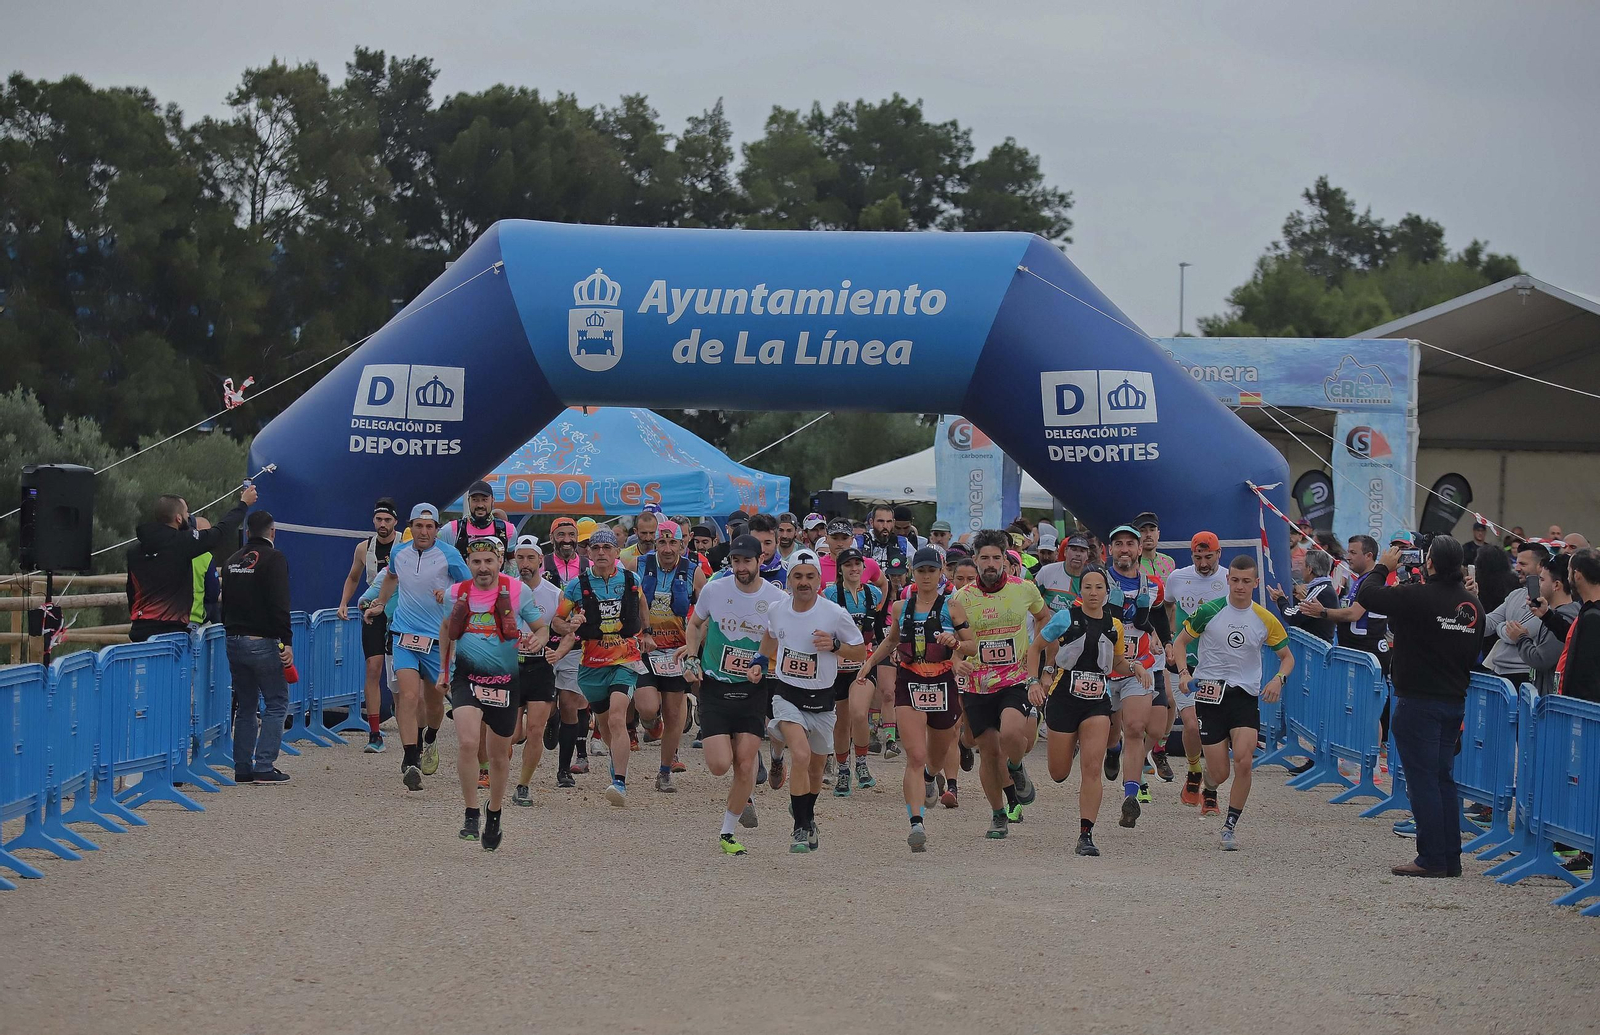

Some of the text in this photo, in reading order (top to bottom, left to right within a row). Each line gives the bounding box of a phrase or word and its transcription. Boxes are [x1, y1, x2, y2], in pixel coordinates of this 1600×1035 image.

[637, 279, 947, 325] Ayuntamiento
[672, 328, 913, 366] de La Línea
[366, 376, 395, 406] D
[1055, 383, 1085, 416] D
[350, 418, 442, 433] DELEGACIÓN DE
[1045, 425, 1137, 439] DELEGACIÓN DE
[350, 435, 461, 455] DEPORTES
[1047, 442, 1160, 463] DEPORTES
[988, 648, 1006, 658] 10
[731, 658, 751, 668] 45
[789, 660, 808, 671] 88
[482, 688, 499, 698] 51
[1081, 681, 1098, 692] 36
[918, 693, 937, 703] 48
